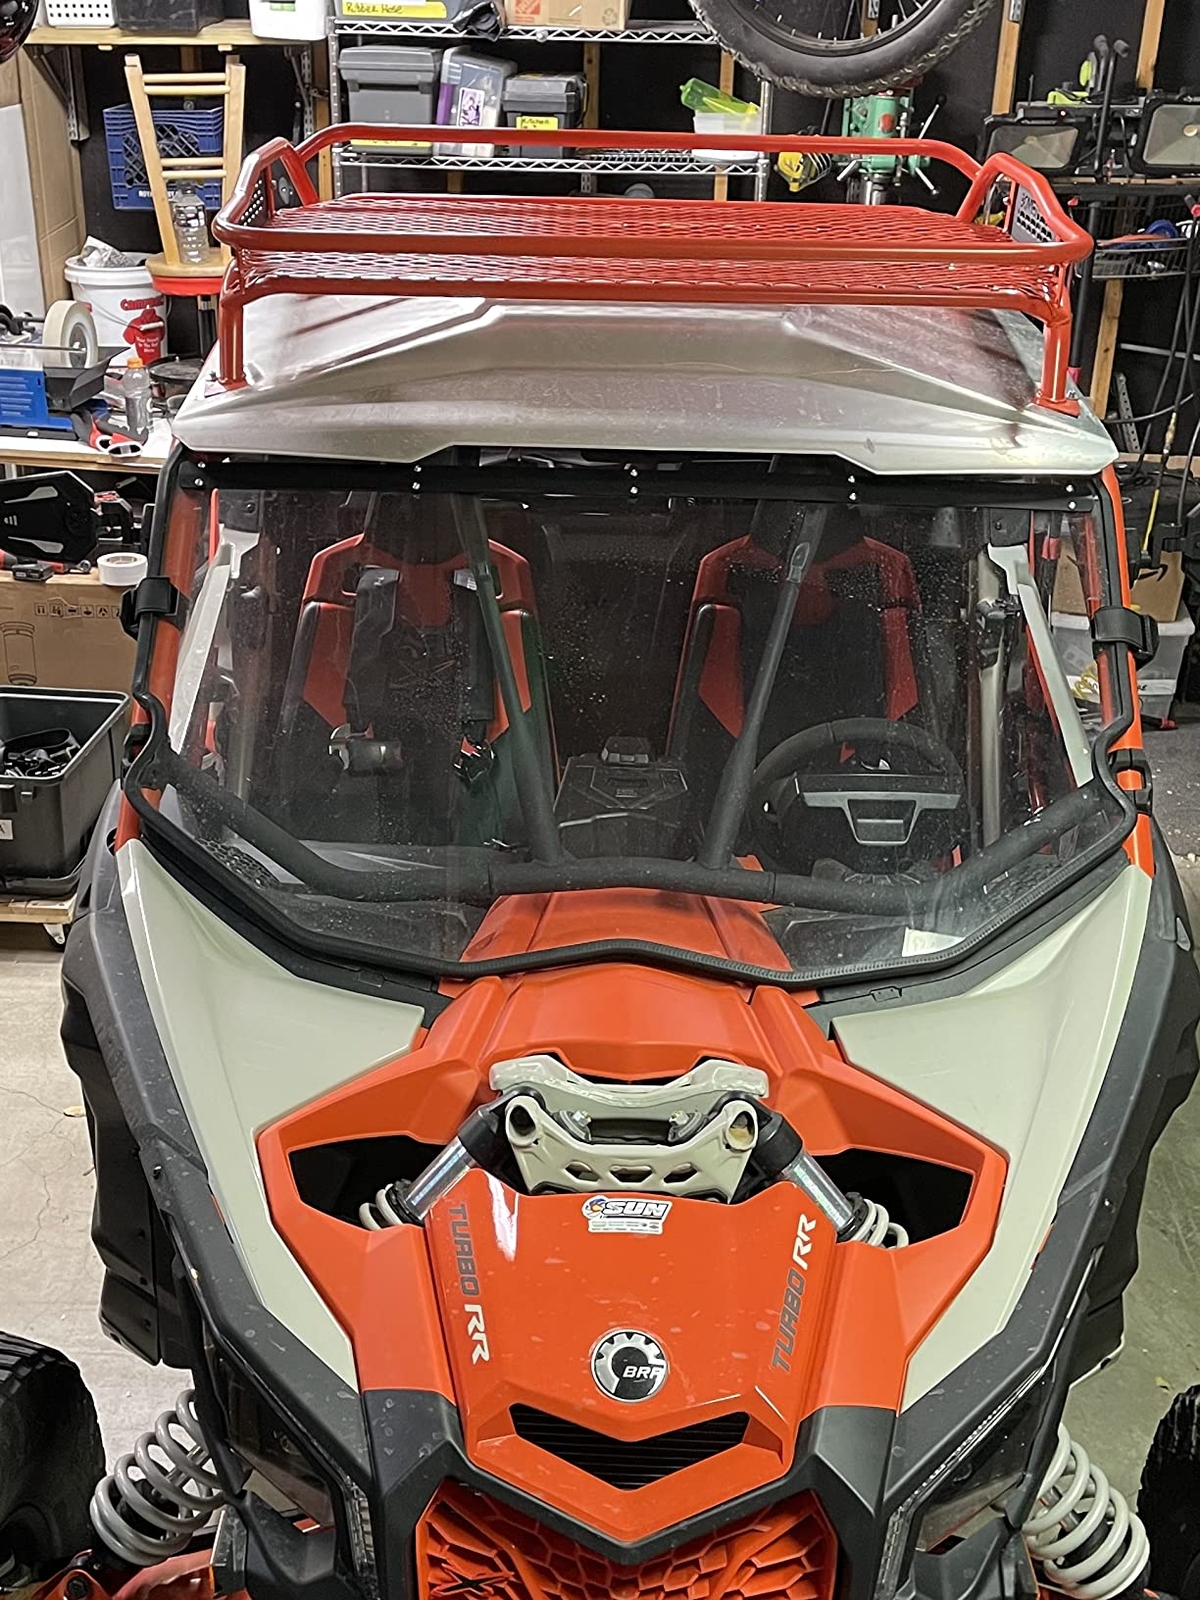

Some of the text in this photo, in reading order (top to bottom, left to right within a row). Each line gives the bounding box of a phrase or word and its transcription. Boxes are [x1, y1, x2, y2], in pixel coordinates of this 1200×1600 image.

[449, 1203, 490, 1365] TURBO RR
[602, 1200, 669, 1218] SUN
[772, 1213, 817, 1372] TURBO RR
